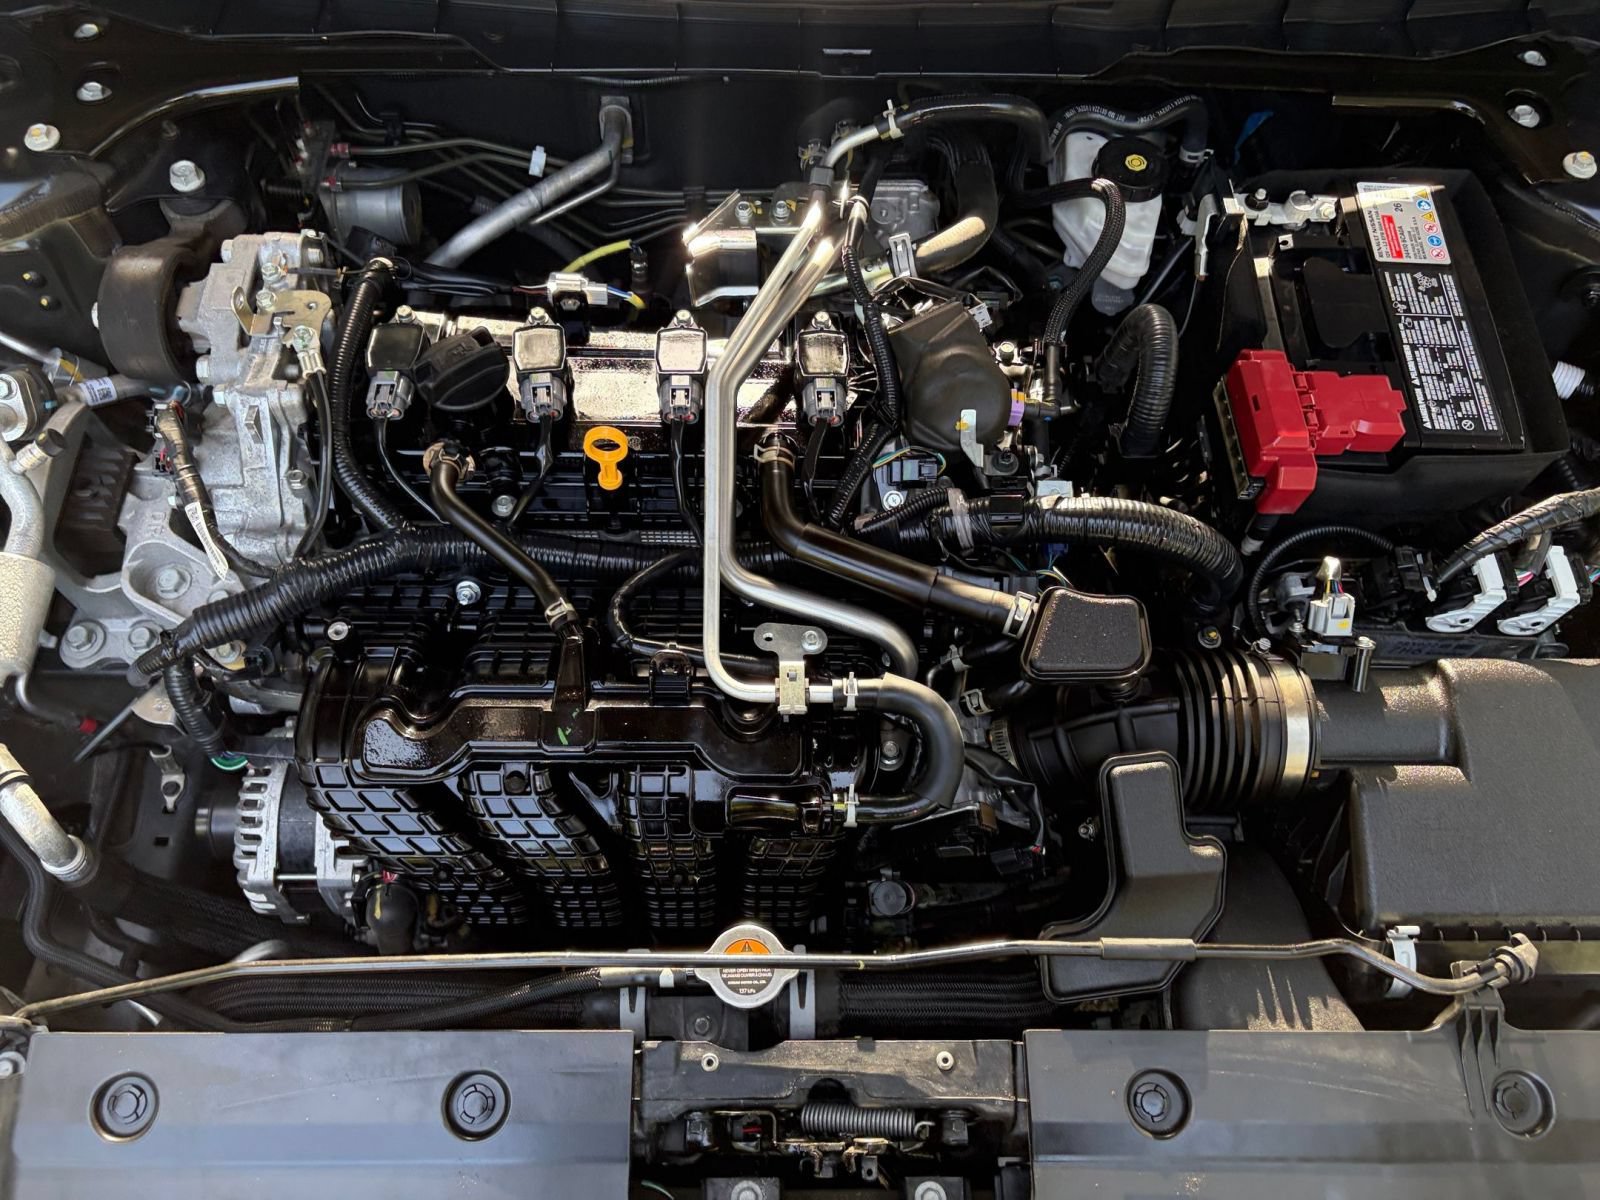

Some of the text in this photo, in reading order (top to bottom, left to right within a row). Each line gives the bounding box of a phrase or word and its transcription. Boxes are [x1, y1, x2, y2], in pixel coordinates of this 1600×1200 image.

[1393, 203, 1402, 211] 26
[1367, 210, 1383, 257] RENAULT NISSAN
